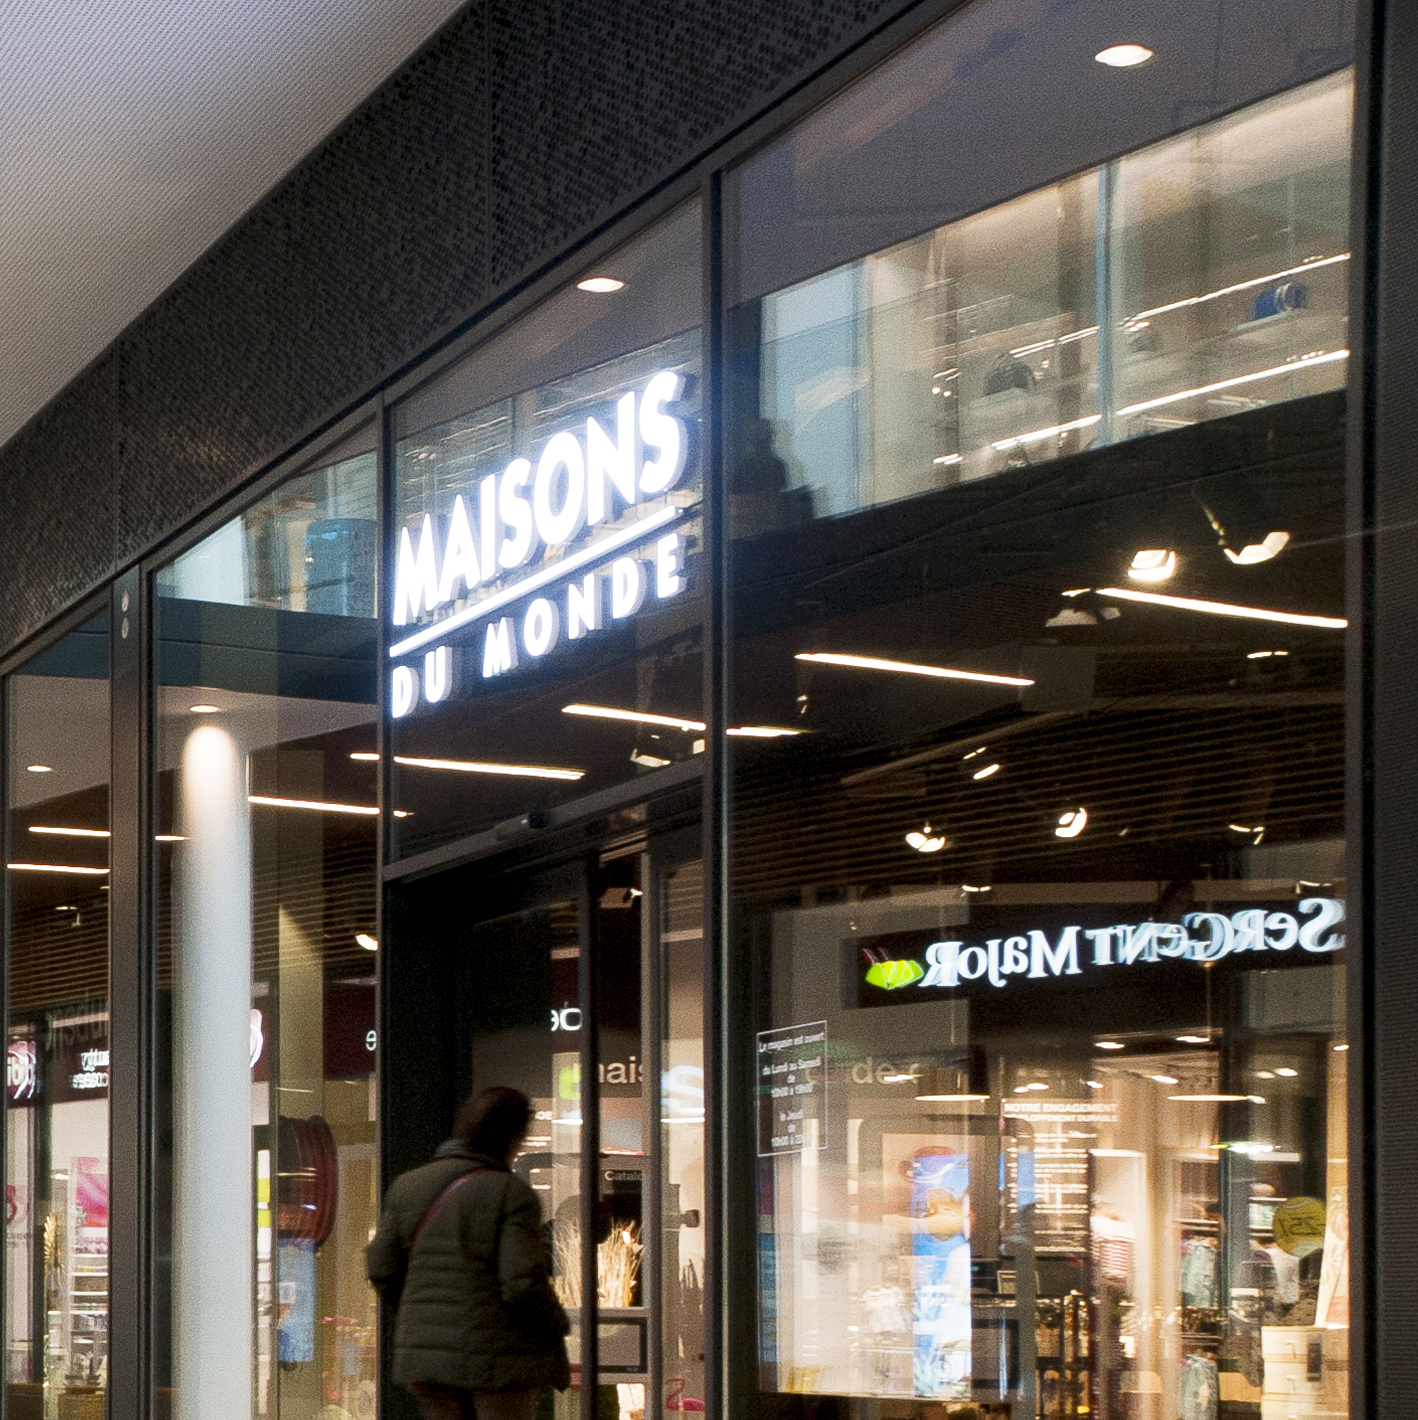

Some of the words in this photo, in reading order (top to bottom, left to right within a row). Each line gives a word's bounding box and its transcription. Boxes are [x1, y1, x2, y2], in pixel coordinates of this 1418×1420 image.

[393, 371, 683, 627] MAISONS
[392, 646, 449, 719] DU
[482, 533, 684, 679] MONDE
